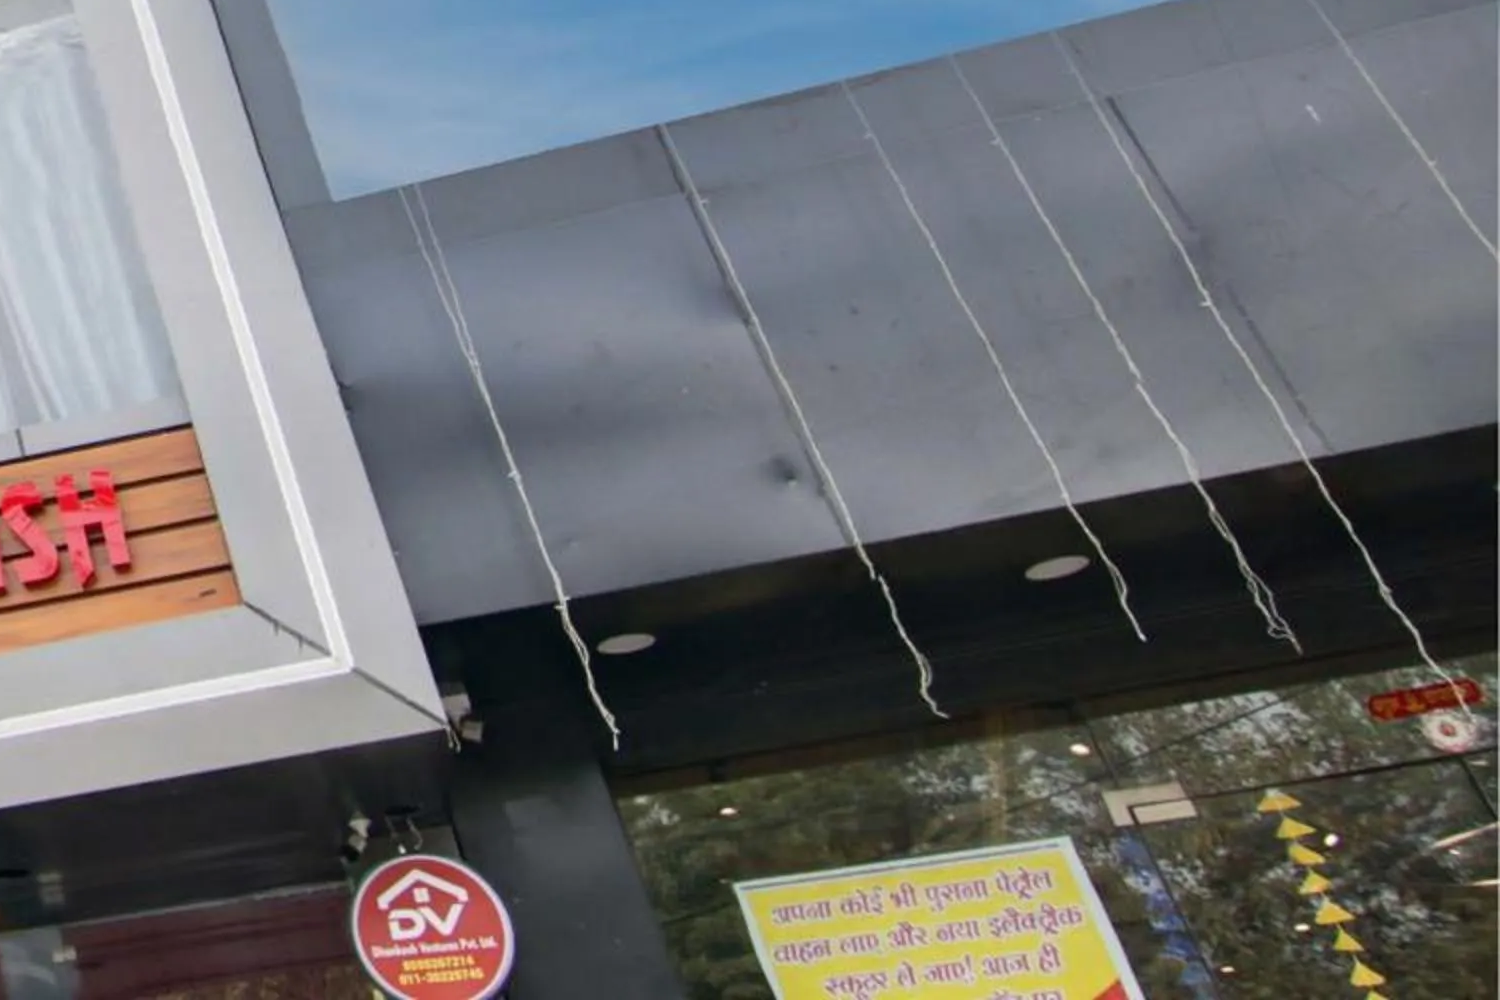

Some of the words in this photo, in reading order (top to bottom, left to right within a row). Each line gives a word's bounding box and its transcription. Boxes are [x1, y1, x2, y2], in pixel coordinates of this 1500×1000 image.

[388, 903, 466, 941] DV
[772, 900, 832, 923] अपना
[840, 885, 884, 915] कोई
[889, 882, 918, 908] भी
[925, 879, 989, 912] पुराना
[773, 938, 832, 963] वाहन
[886, 920, 929, 948] और
[936, 920, 981, 942] नया
[897, 961, 917, 986] ले
[982, 953, 1031, 976] आज
[1038, 942, 1061, 973] ही
